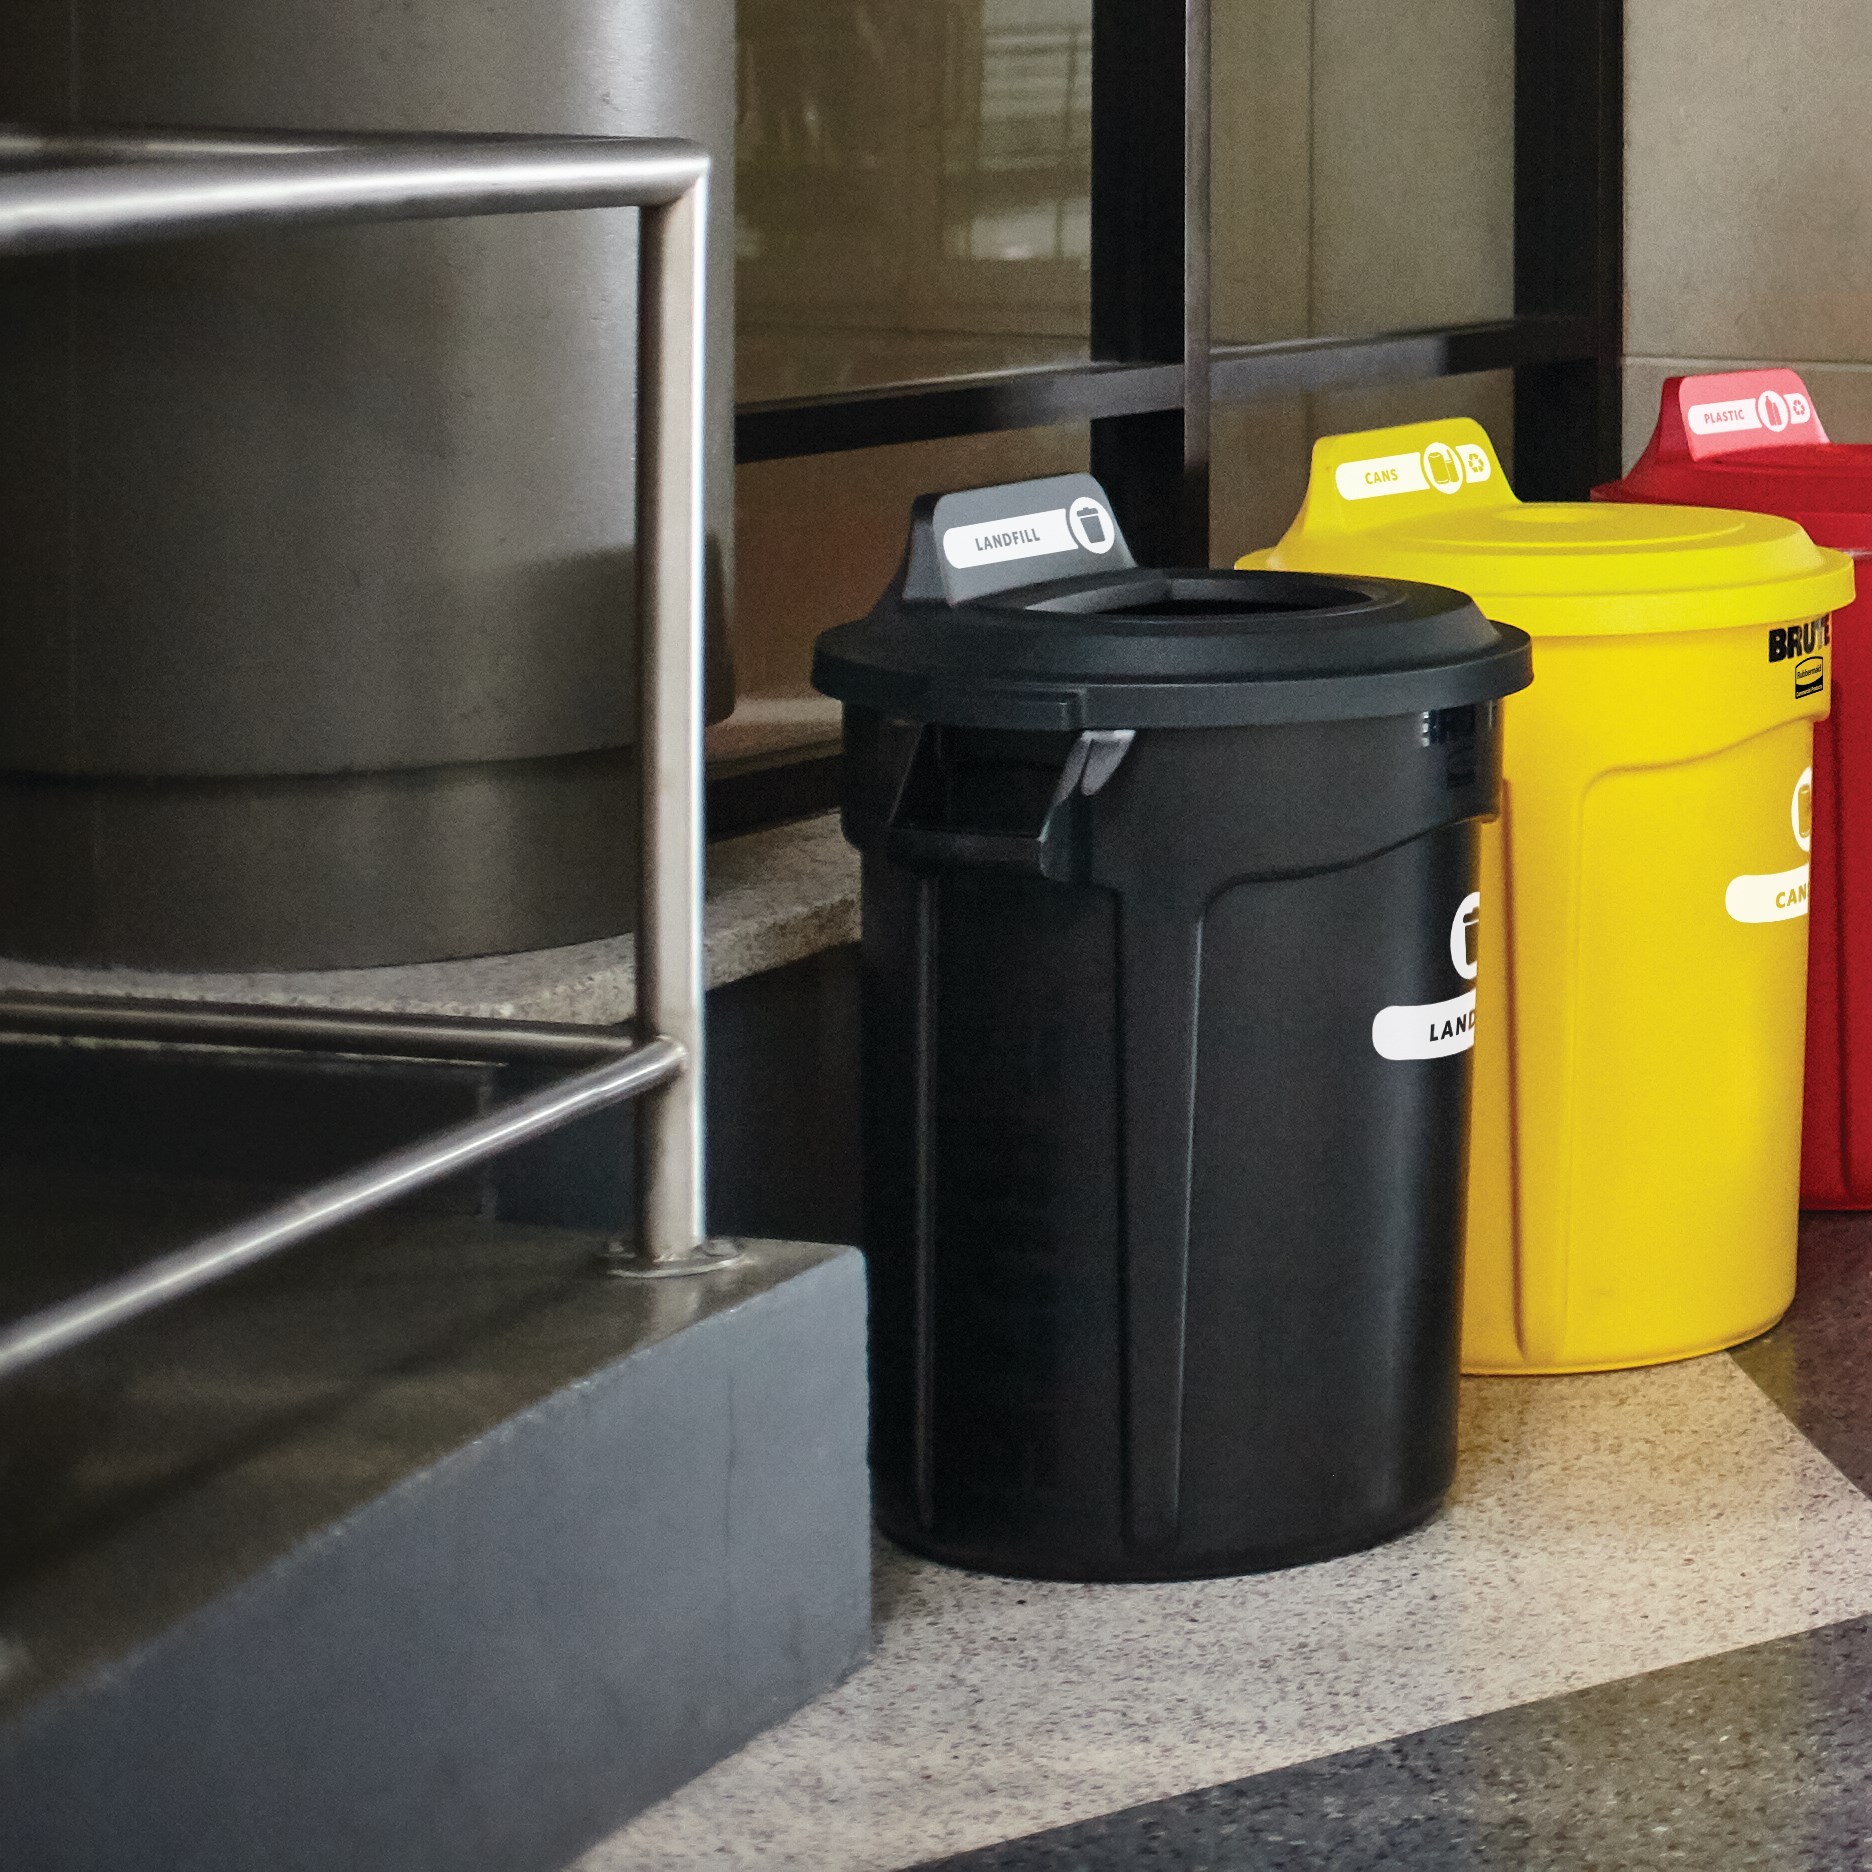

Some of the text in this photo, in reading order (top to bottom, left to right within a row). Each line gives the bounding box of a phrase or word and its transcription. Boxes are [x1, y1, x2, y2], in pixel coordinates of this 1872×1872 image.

[1704, 409, 1745, 424] PLASTIC
[1365, 468, 1398, 485] CANS
[975, 528, 1041, 551] LANDFILL
[1796, 663, 1822, 680] Rubbermaid
